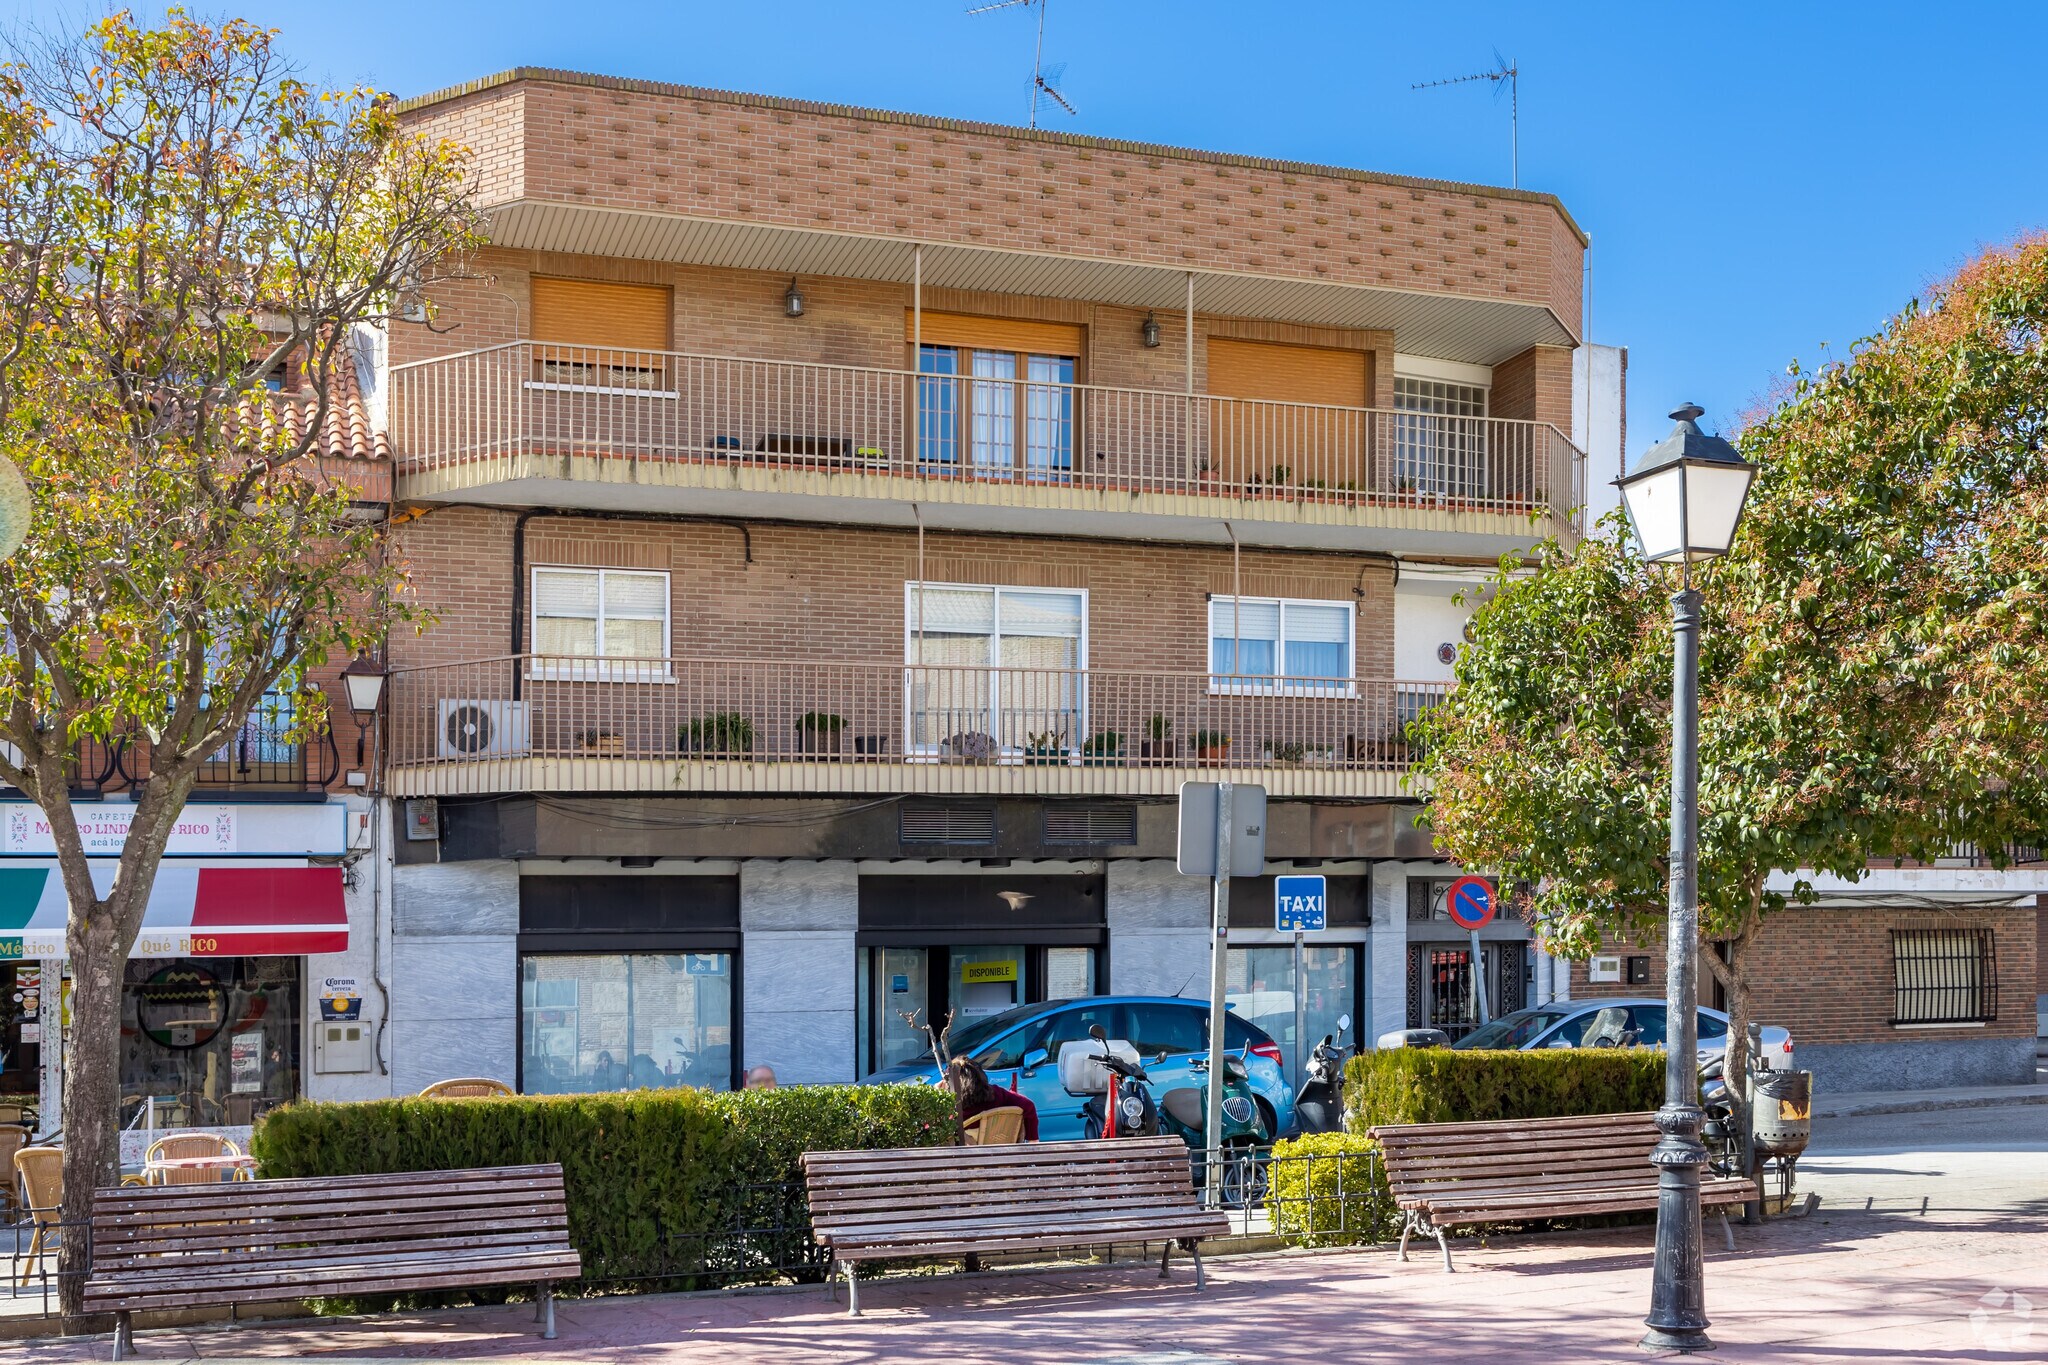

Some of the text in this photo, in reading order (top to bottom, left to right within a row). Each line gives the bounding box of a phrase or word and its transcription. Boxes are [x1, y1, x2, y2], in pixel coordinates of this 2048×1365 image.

[95, 823, 129, 834] LIND
[178, 824, 210, 835] RICO
[90, 837, 108, 846] acá
[1280, 895, 1323, 912] TAXI
[0, 941, 55, 956] México
[141, 937, 171, 954] Qué
[179, 938, 218, 952] RICO
[969, 966, 1010, 978] DISPONIBLE
[325, 978, 355, 987] Corona
